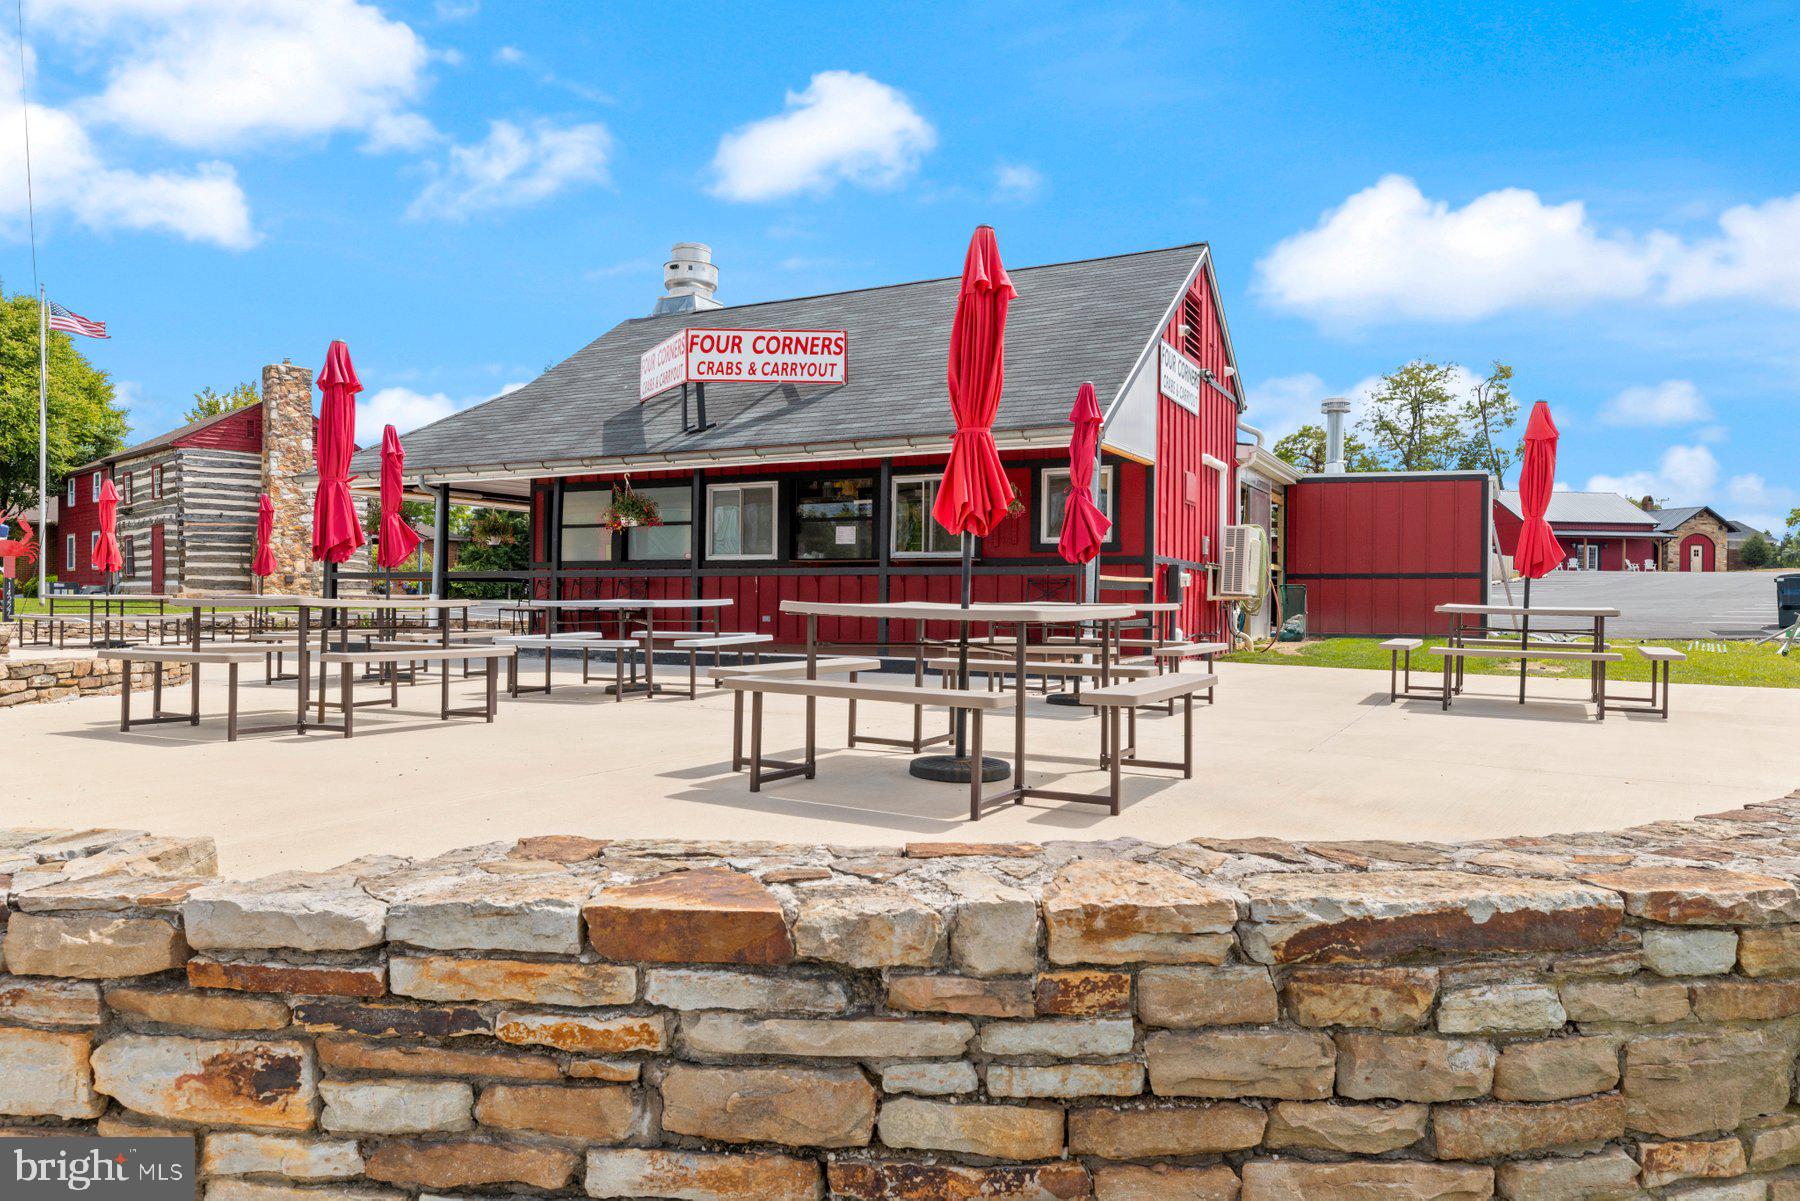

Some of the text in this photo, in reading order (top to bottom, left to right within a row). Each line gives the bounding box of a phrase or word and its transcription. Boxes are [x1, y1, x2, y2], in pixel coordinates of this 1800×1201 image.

[689, 335, 844, 356] FOUR CORNERS
[697, 361, 837, 378] CRABS & CARRYOUT
